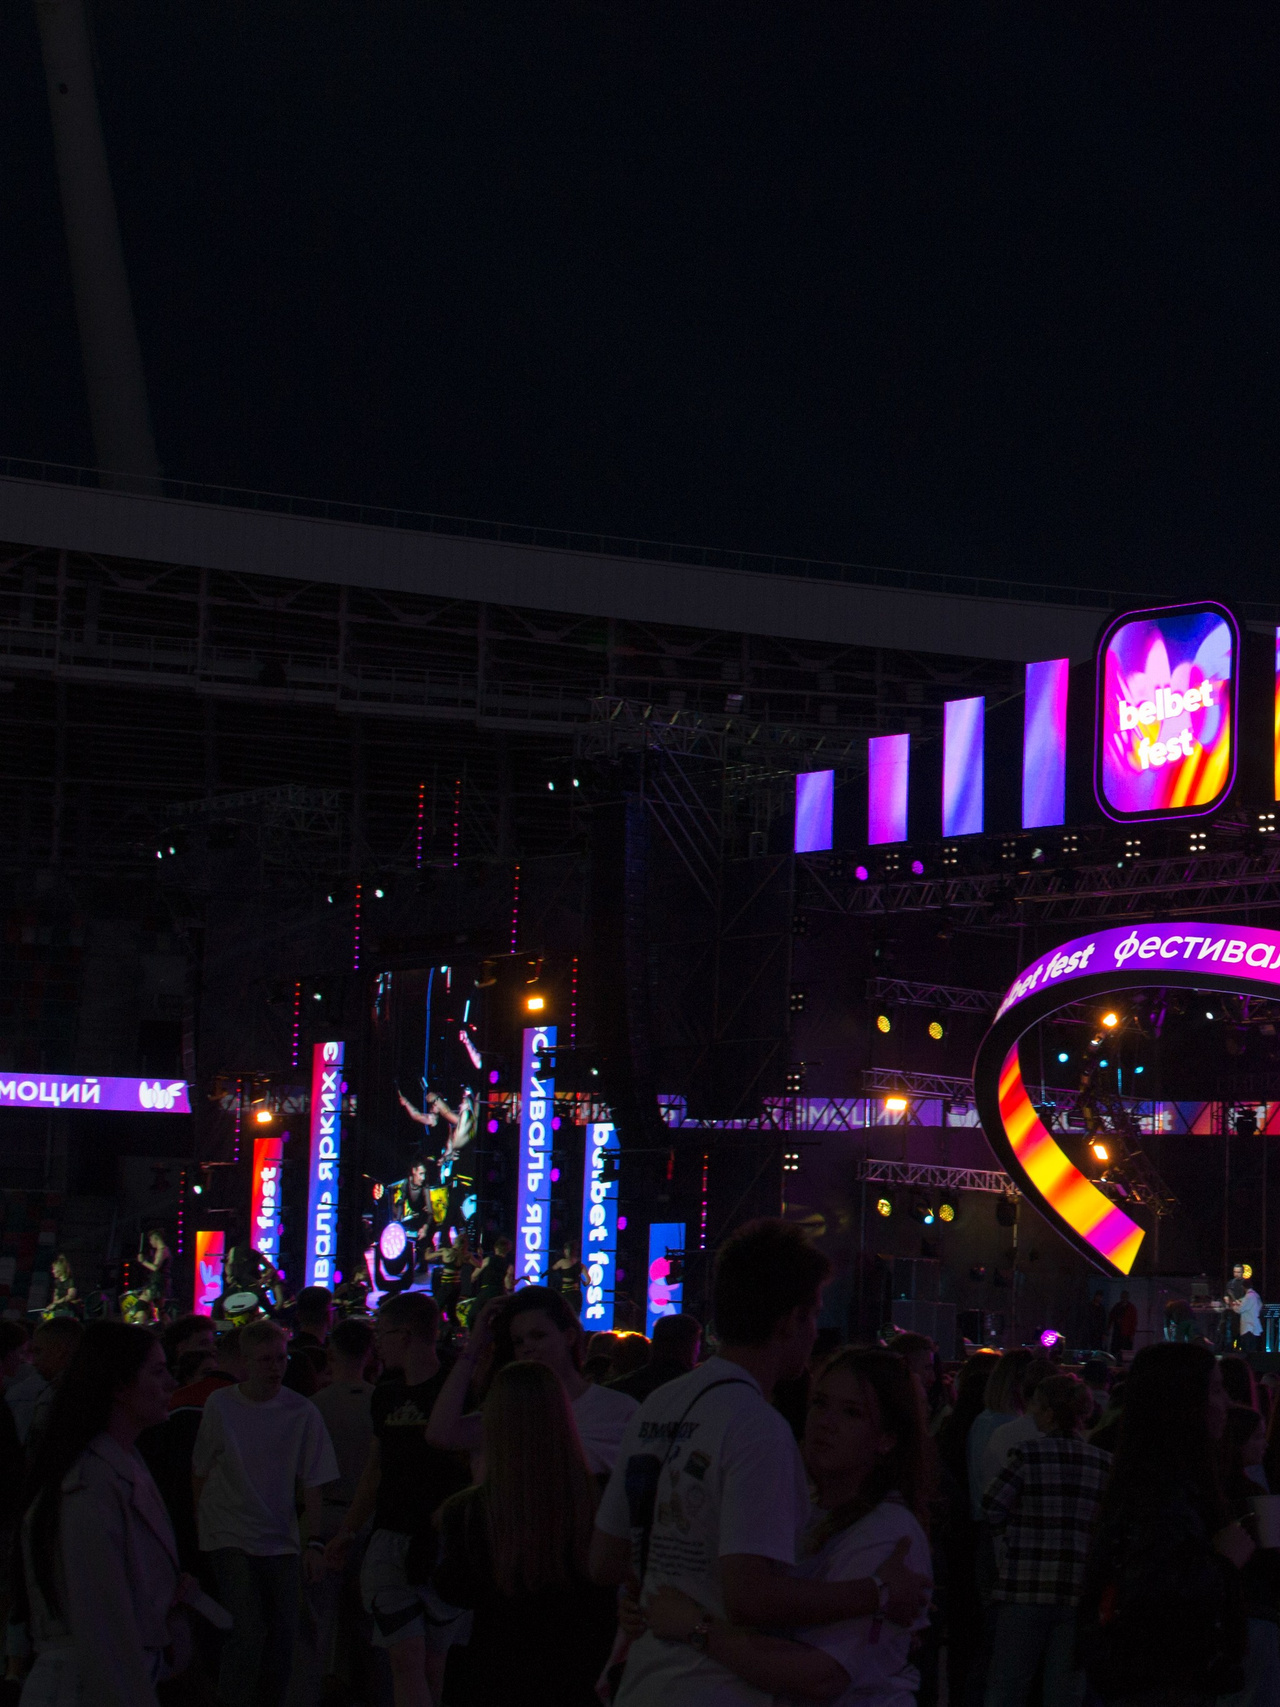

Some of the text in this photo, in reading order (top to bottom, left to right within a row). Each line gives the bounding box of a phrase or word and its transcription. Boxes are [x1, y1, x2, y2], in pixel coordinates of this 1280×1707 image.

[1119, 679, 1214, 731] belbet
[1138, 728, 1194, 770] fest
[1042, 943, 1096, 983] fest
[318, 1071, 338, 1181] ярких
[257, 1166, 277, 1229] fest
[586, 1252, 610, 1319] fest
